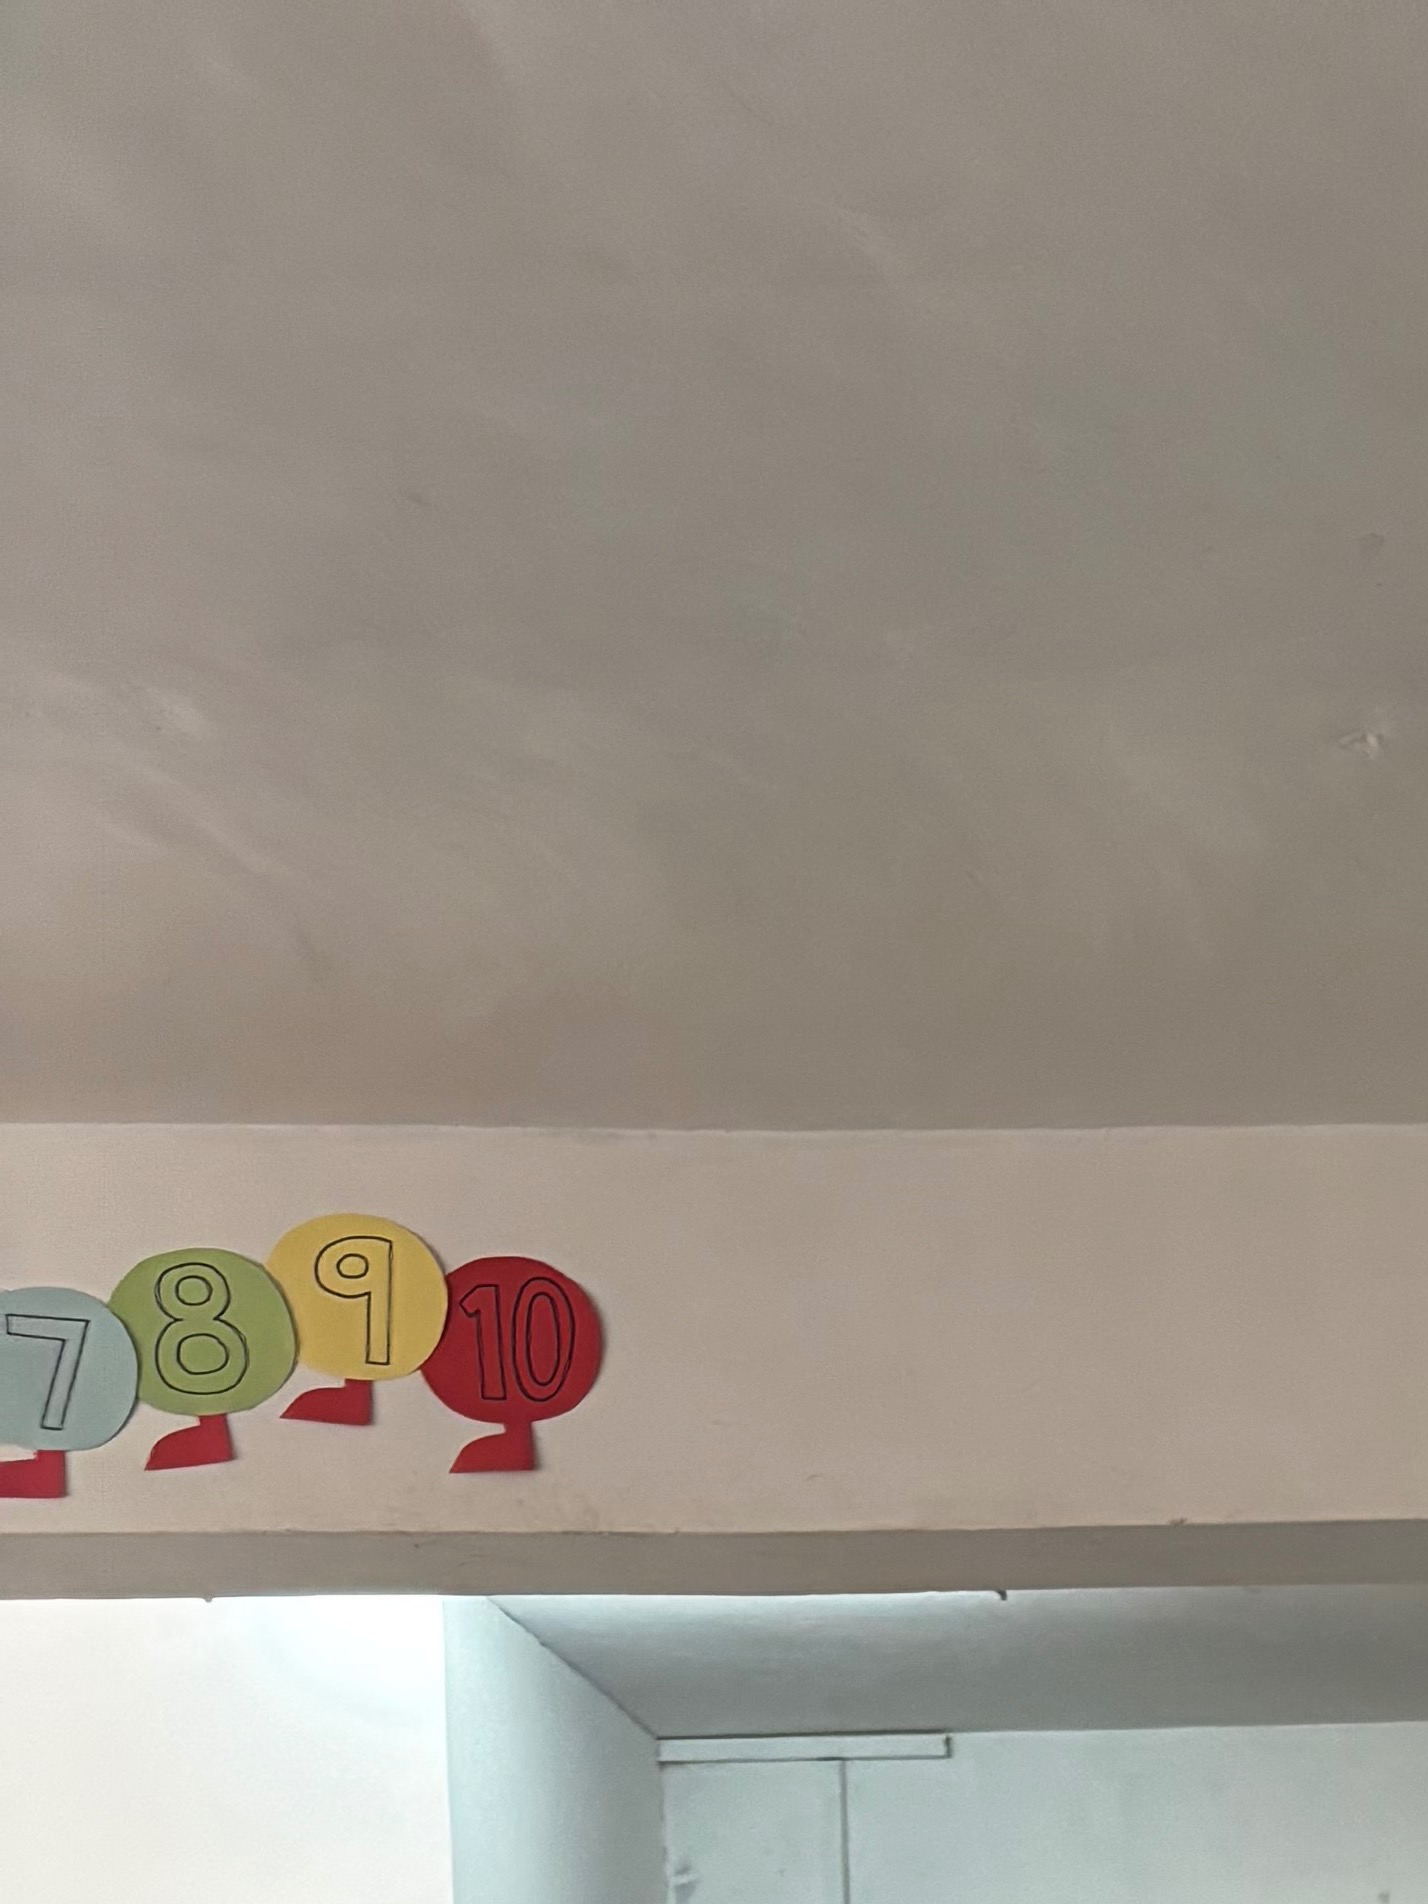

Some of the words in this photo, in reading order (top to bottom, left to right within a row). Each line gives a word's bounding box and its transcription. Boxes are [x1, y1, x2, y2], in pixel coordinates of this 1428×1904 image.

[5, 1312, 91, 1431] 7
[154, 1262, 250, 1395] 8
[314, 1235, 394, 1366] 9
[459, 1276, 576, 1402] 10
